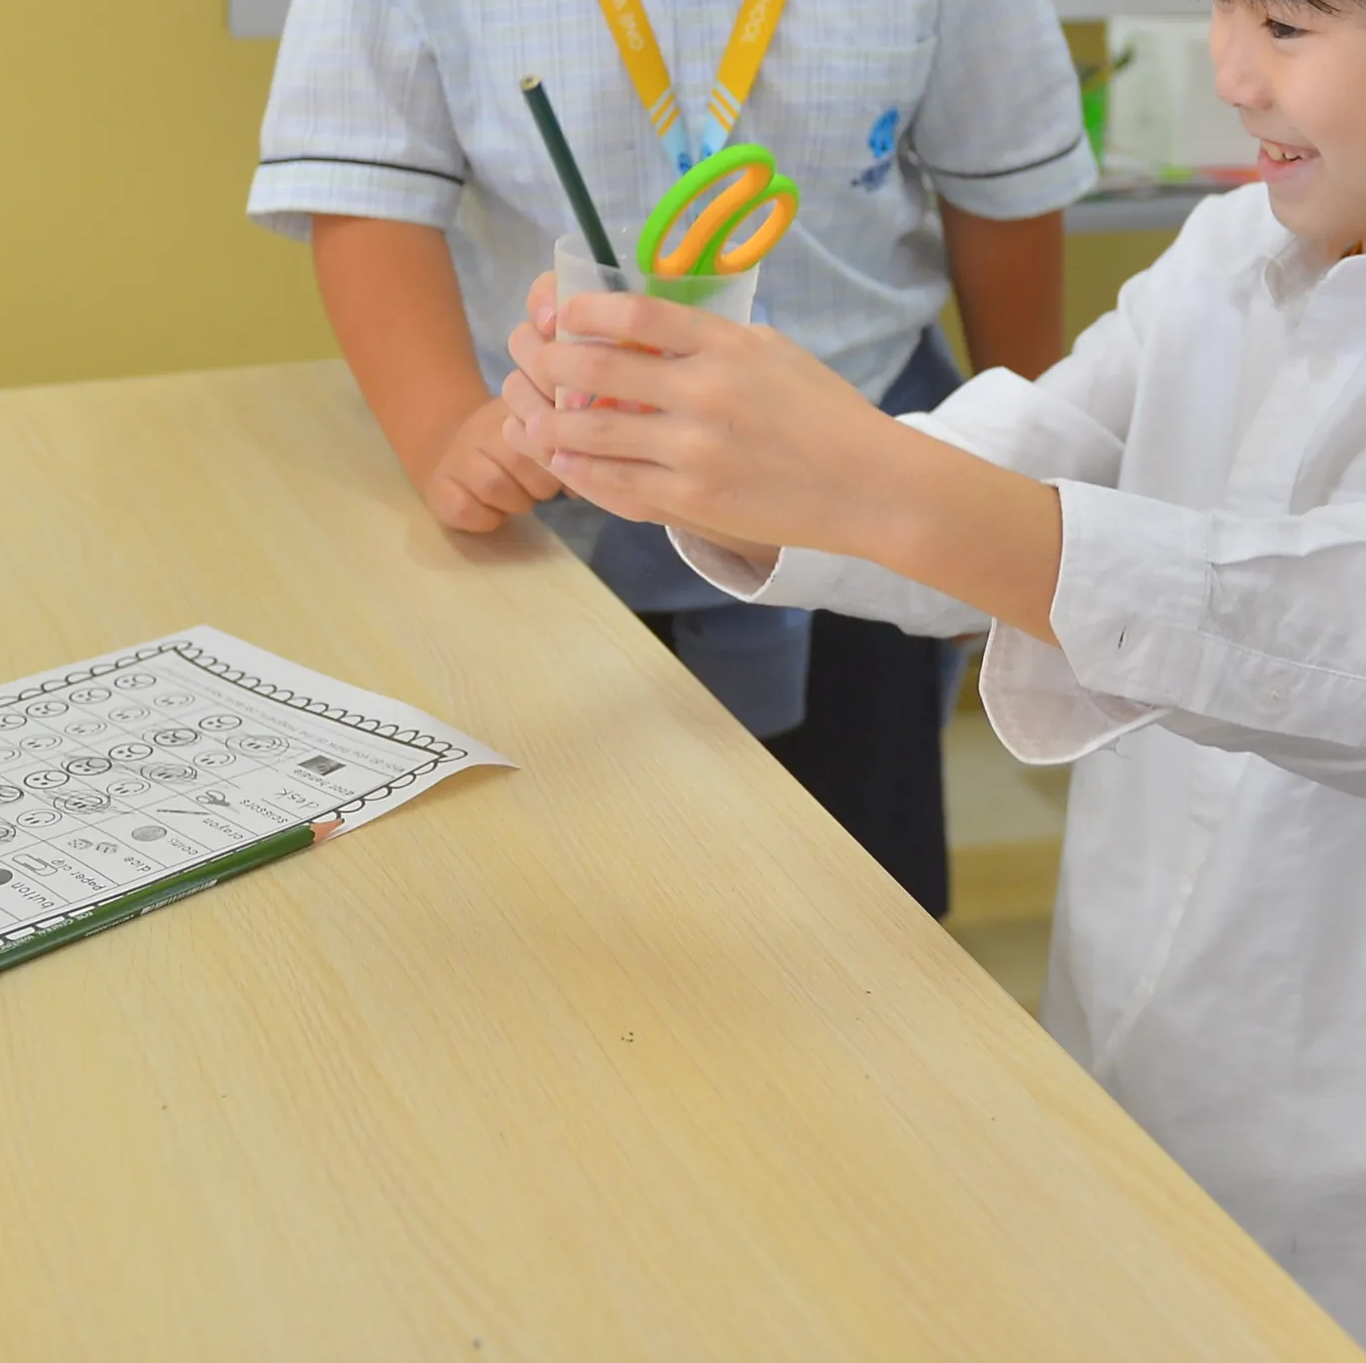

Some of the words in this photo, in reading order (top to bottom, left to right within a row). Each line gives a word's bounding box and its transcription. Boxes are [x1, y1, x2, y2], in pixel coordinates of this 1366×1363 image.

[293, 768, 331, 787] handle
[274, 787, 320, 810] desk
[327, 784, 355, 796] door
[239, 799, 289, 824] scissors
[202, 817, 244, 840] crayon
[167, 837, 199, 855] coins
[44, 859, 73, 872] clip
[123, 856, 152, 873] dice
[69, 871, 107, 891] paper
[10, 881, 55, 909] button
